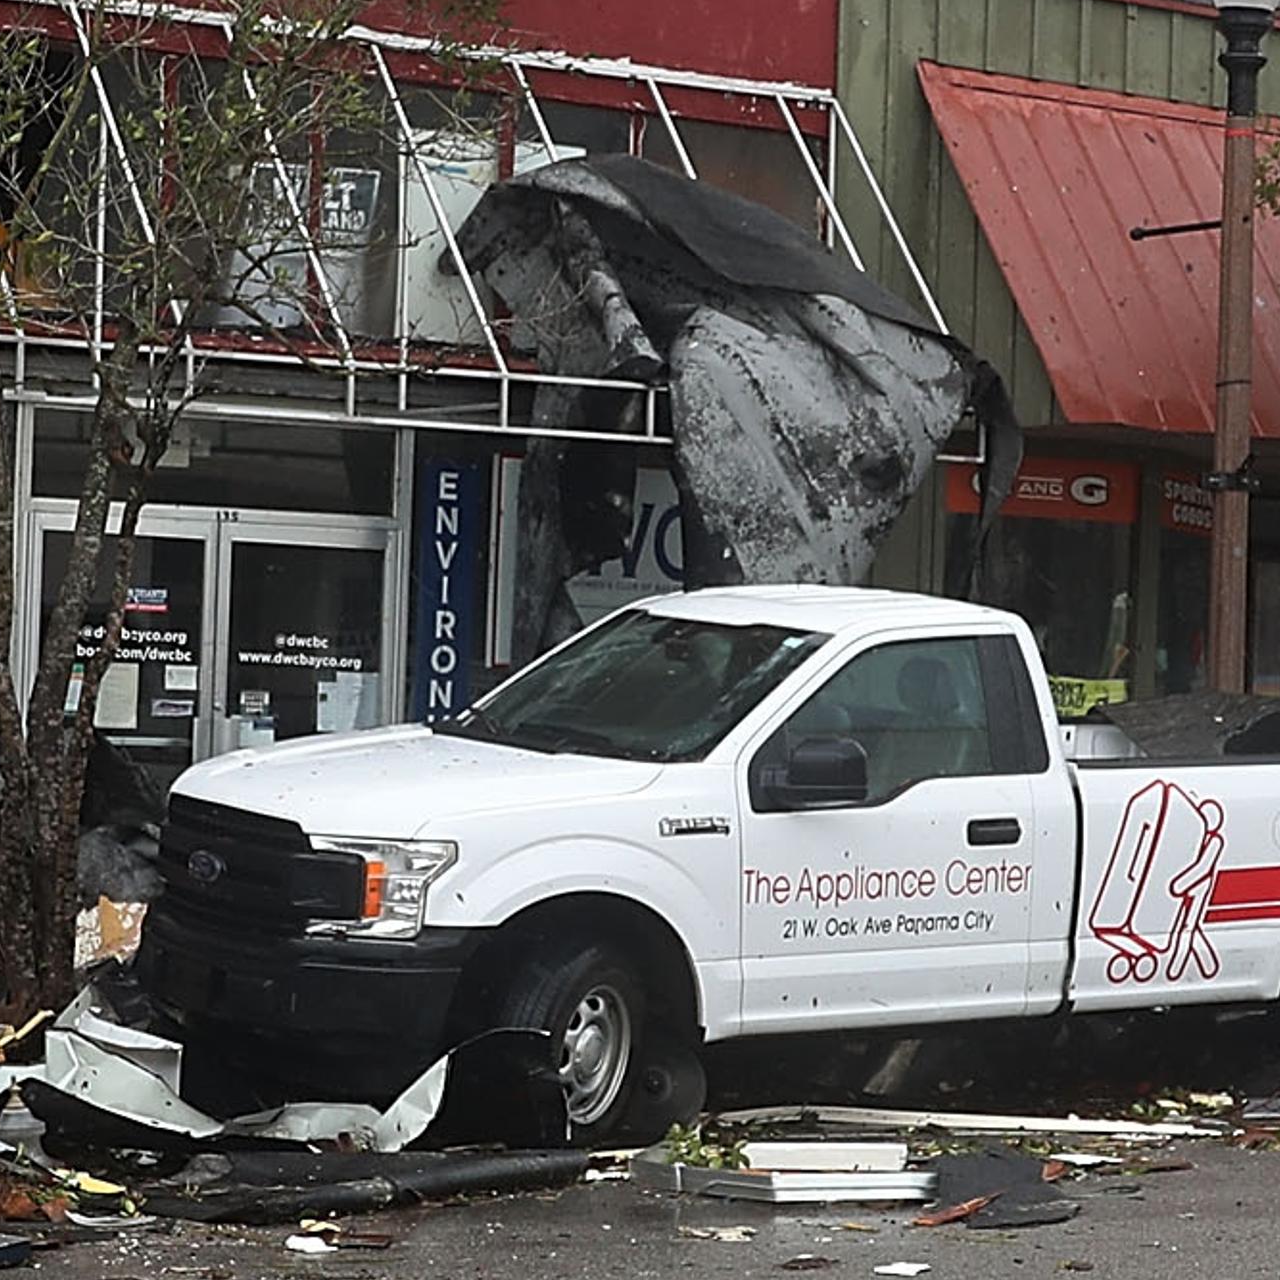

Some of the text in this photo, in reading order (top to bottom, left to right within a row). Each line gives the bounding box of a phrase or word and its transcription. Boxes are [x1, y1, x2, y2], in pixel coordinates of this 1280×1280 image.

[1019, 474, 1108, 504] AND G
[428, 472, 460, 722] ENVIRON
[275, 634, 330, 650] @dwcbc
[238, 651, 363, 670] www.dwcbayco.org
[743, 859, 1033, 908] The Appliance Center
[782, 910, 994, 939] 21 W. Oak Ave Panama City
